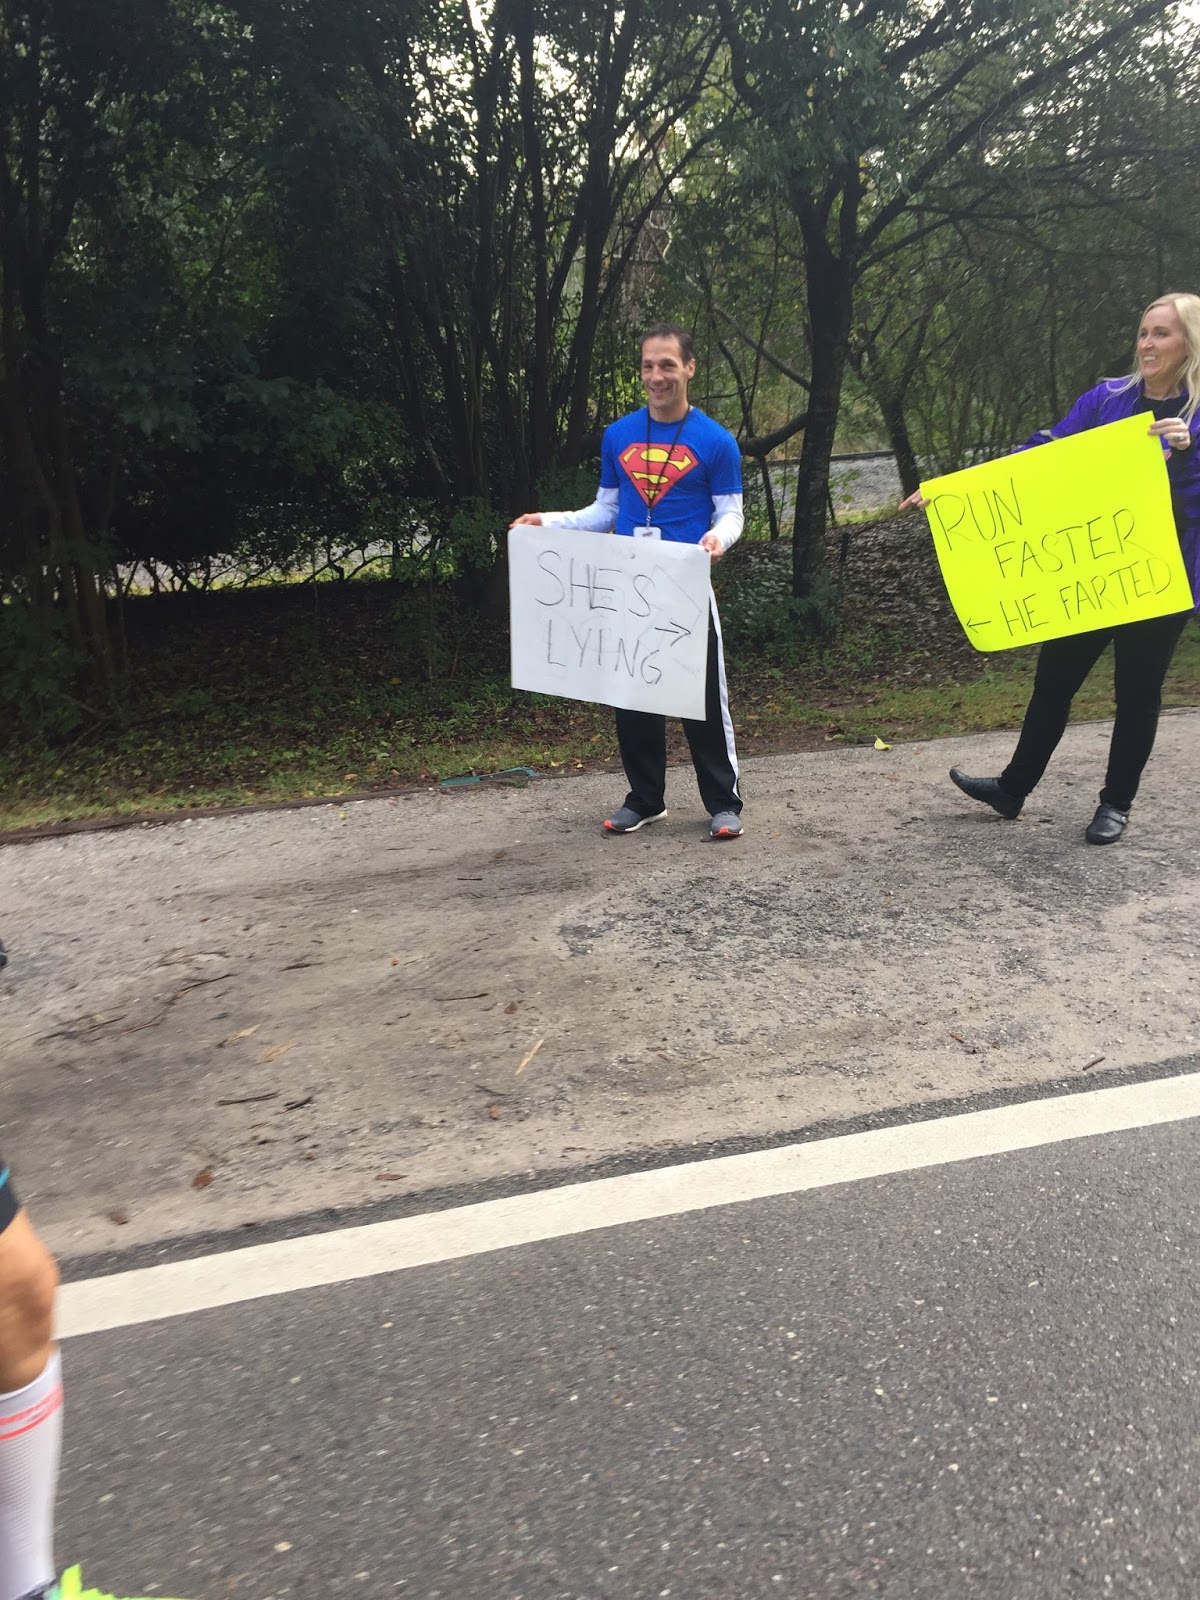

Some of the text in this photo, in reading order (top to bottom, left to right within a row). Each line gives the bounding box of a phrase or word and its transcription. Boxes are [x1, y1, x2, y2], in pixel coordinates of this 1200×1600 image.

[618, 443, 699, 508] S
[933, 477, 1023, 551] RUN
[994, 508, 1155, 579] FASTER
[1000, 557, 1172, 636] HE FARTED
[546, 619, 662, 685] LYING
